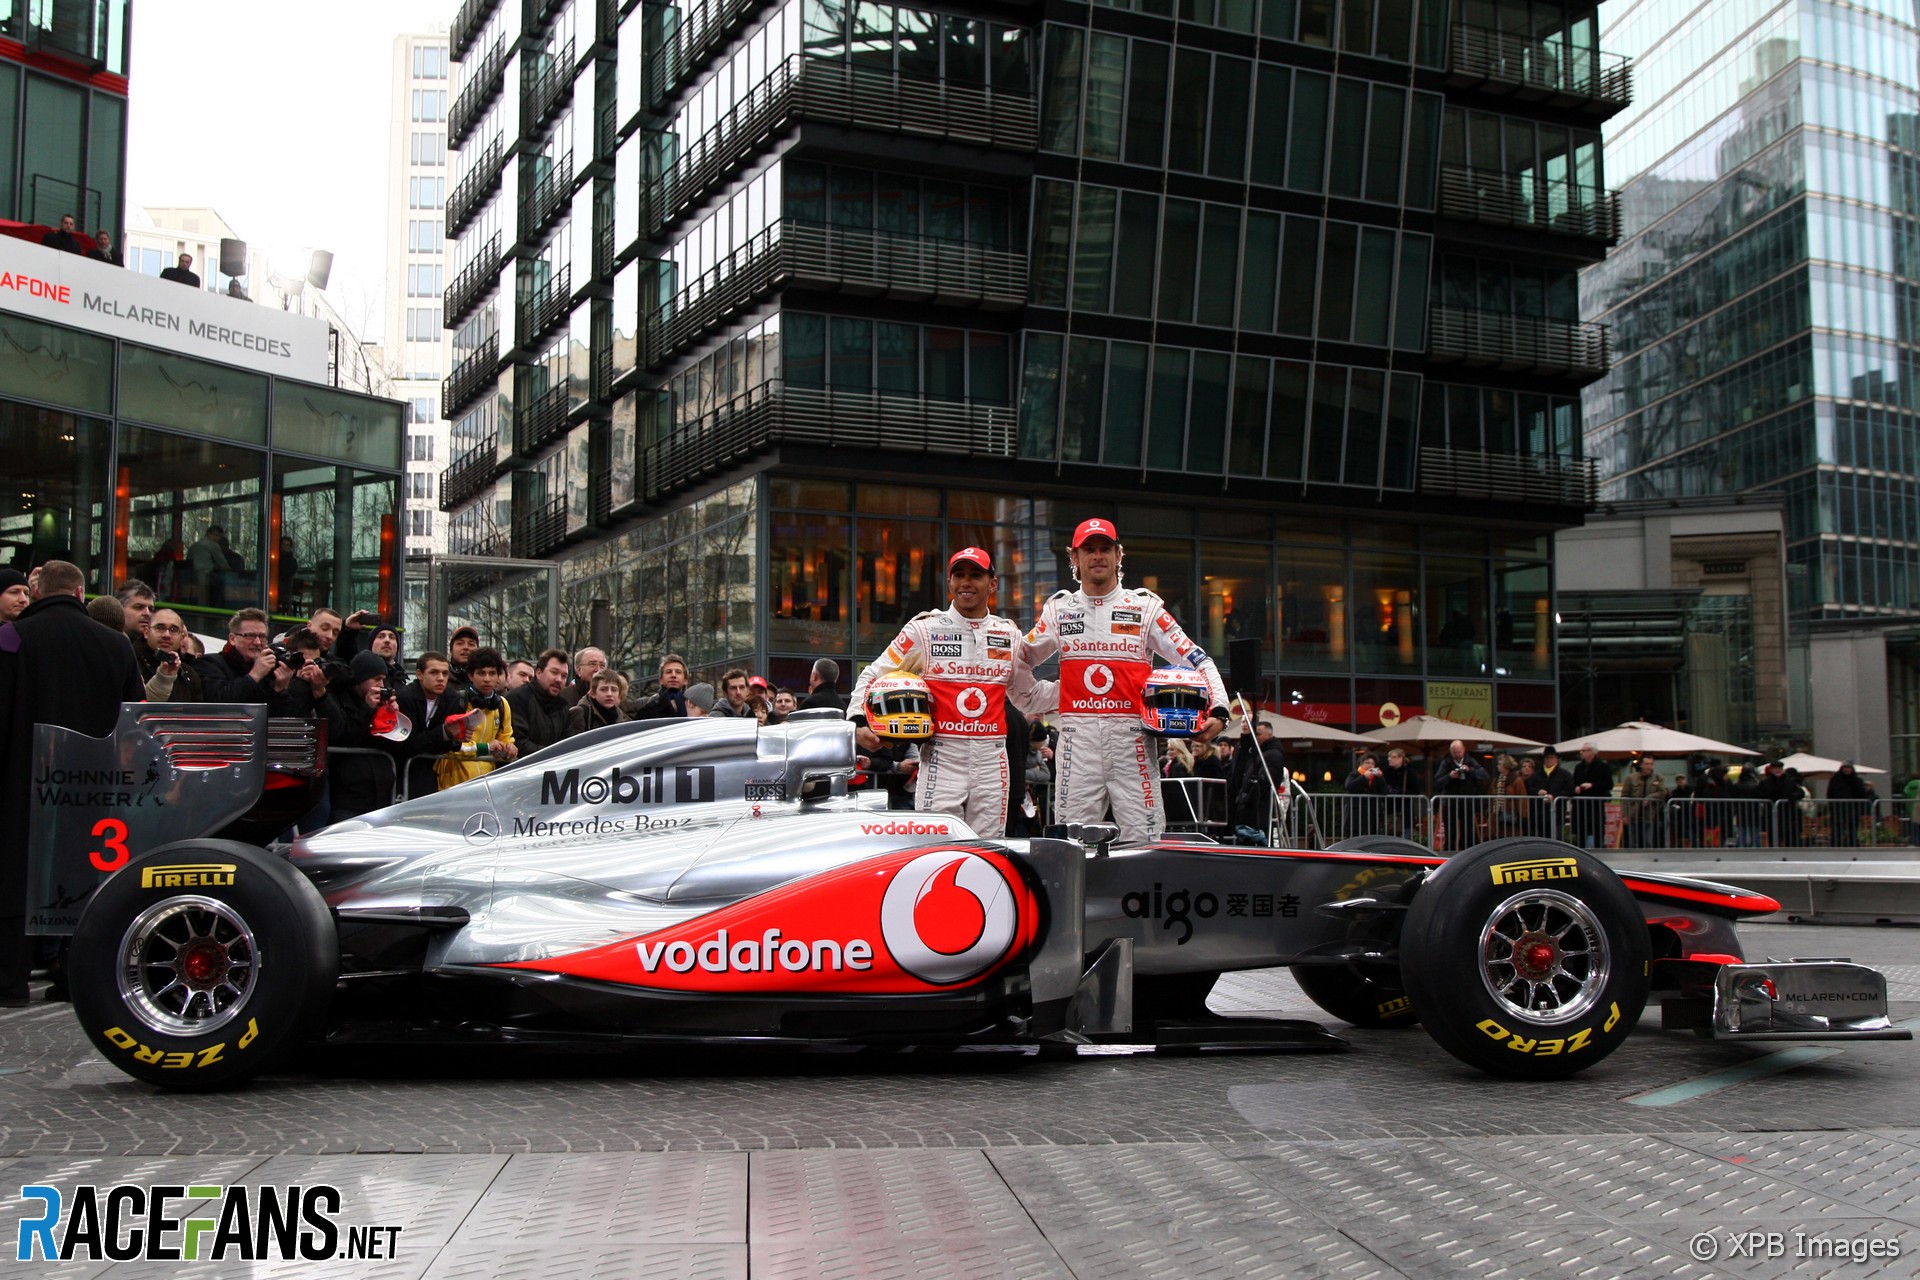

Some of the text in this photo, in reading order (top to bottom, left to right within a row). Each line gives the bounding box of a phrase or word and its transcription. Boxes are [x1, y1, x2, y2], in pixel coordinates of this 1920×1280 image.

[83, 292, 180, 331] McLAREN
[189, 319, 292, 357] MERCEDES
[1061, 623, 1083, 632] BOSS
[932, 645, 961, 653] BOSS
[1073, 639, 1139, 653] Santander
[948, 661, 1012, 677] Santander
[1072, 697, 1132, 709] vodafone
[1429, 686, 1489, 698] RESTAURANT
[938, 720, 998, 732] vodafone
[35, 766, 135, 786] JOHNNIE
[1060, 735, 1073, 808] MERCEDES
[1135, 735, 1154, 808] VODAFONE
[37, 787, 132, 807] WALKER
[540, 767, 664, 805] Mobil
[747, 785, 784, 797] BOSS
[999, 751, 1008, 824] VODAFONE
[513, 814, 692, 838] Mercedes-Benz
[860, 822, 949, 836] vodafone
[88, 817, 131, 872] 3
[141, 863, 237, 888] PIRELLI
[1490, 857, 1579, 885] PIRELLI
[1121, 882, 1219, 946] aigo
[1226, 893, 1301, 918] 爱国者
[636, 928, 873, 973] vodafone
[1476, 1001, 1621, 1056] P ZERO
[103, 1017, 259, 1068] P ZERO
